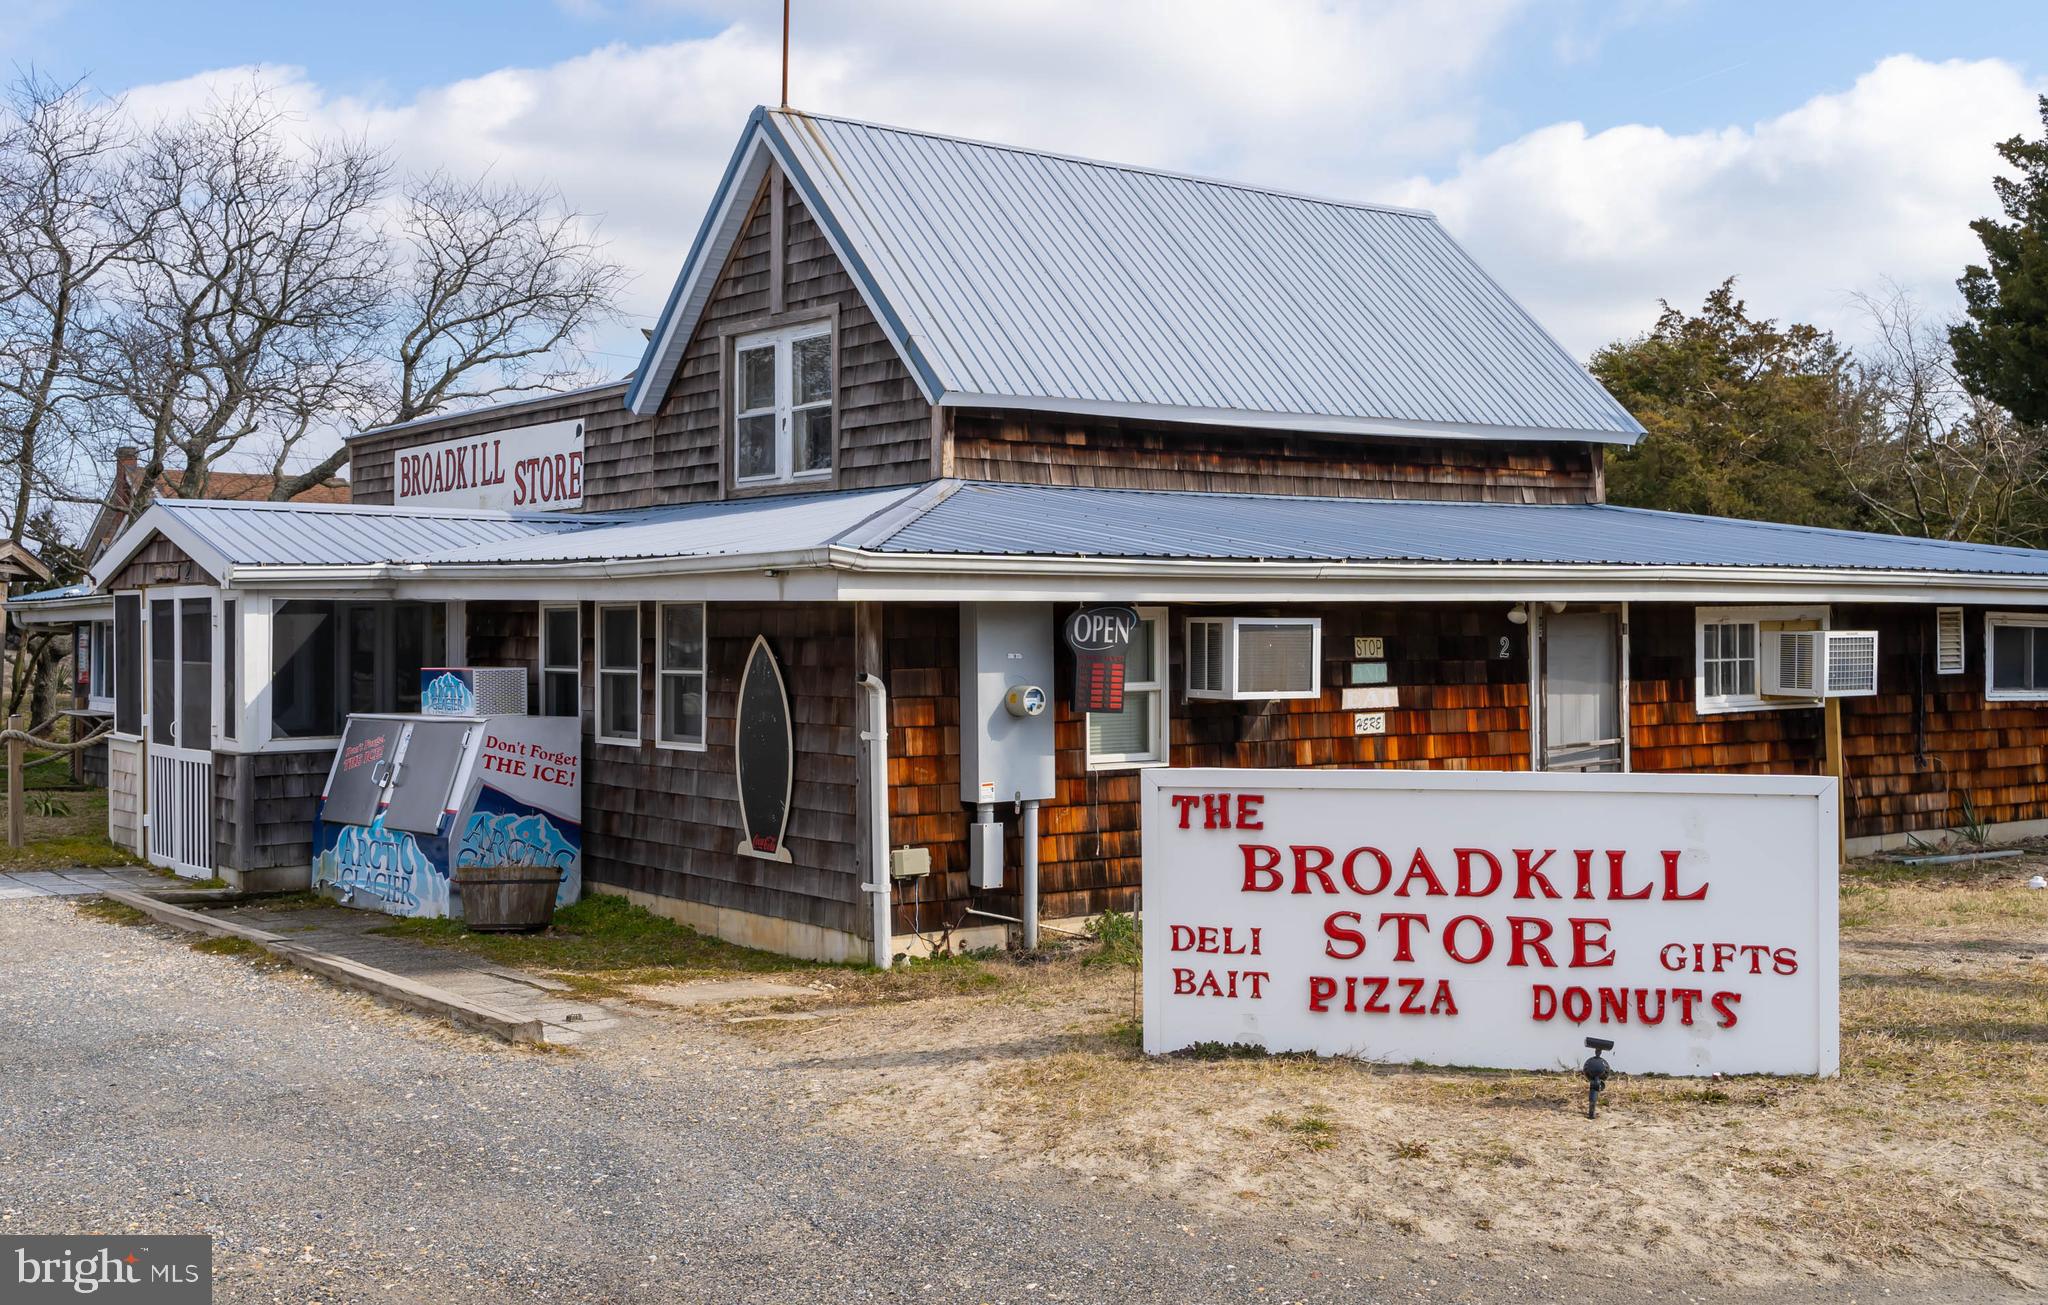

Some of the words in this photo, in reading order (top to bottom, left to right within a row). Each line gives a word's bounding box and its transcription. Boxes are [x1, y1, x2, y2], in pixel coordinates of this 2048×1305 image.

[400, 440, 505, 497] BROADKILL
[514, 451, 583, 505] STORE
[1074, 614, 1130, 644] OPEN
[1356, 639, 1382, 656] STOP
[1499, 635, 1510, 658] 2
[1355, 716, 1382, 731] HERE
[486, 735, 526, 755] Don't
[530, 744, 578, 767] Forget
[482, 754, 527, 777] THE
[532, 764, 576, 787] ICE!
[1172, 794, 1265, 832] THE
[342, 828, 415, 875] ARCTIC
[341, 868, 414, 906] GLACIER
[1239, 843, 1709, 902] BROADKILL
[1170, 925, 1262, 955] DELI
[1324, 911, 1616, 968] STORE
[1660, 943, 1798, 975] GIFTS
[1173, 968, 1270, 999] BAIT
[1309, 975, 1458, 1016] PIZZA
[1533, 984, 1742, 1029] DONUTS
